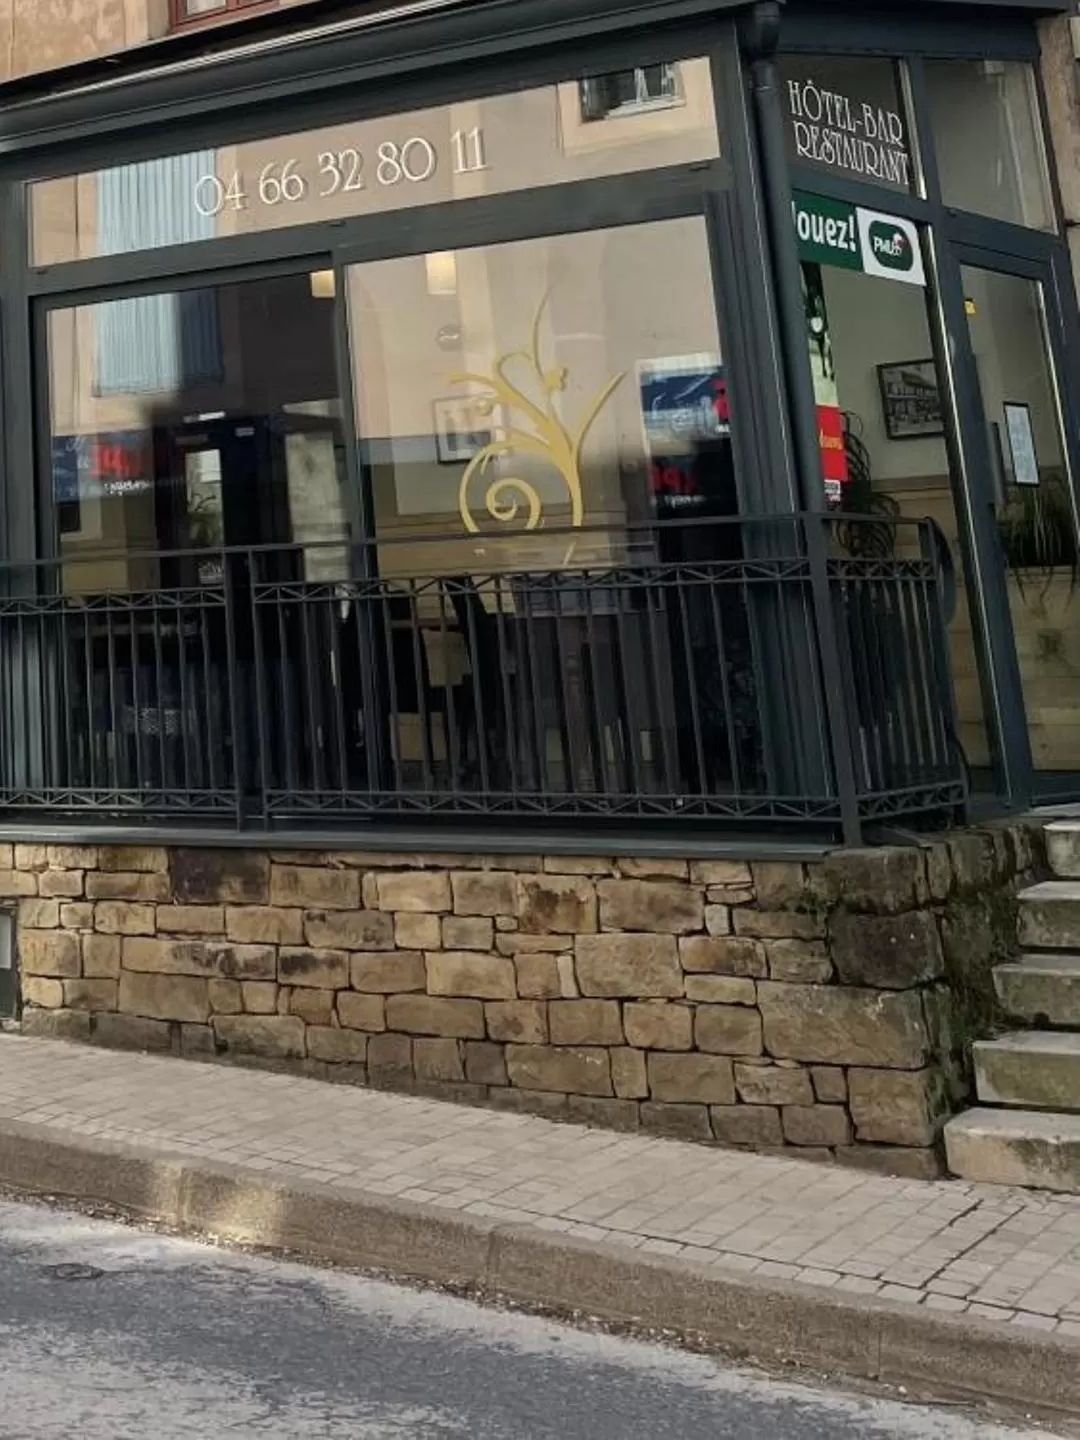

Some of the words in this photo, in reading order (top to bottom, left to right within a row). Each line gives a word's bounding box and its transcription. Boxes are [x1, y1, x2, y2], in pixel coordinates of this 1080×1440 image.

[193, 170, 248, 216] 04
[259, 159, 305, 205] 66
[318, 148, 364, 196] 32
[376, 137, 437, 186] 80
[450, 126, 489, 174] 11
[793, 120, 910, 185] RESTAURANT
[791, 200, 857, 253] ouez!
[873, 236, 895, 256] PMU
